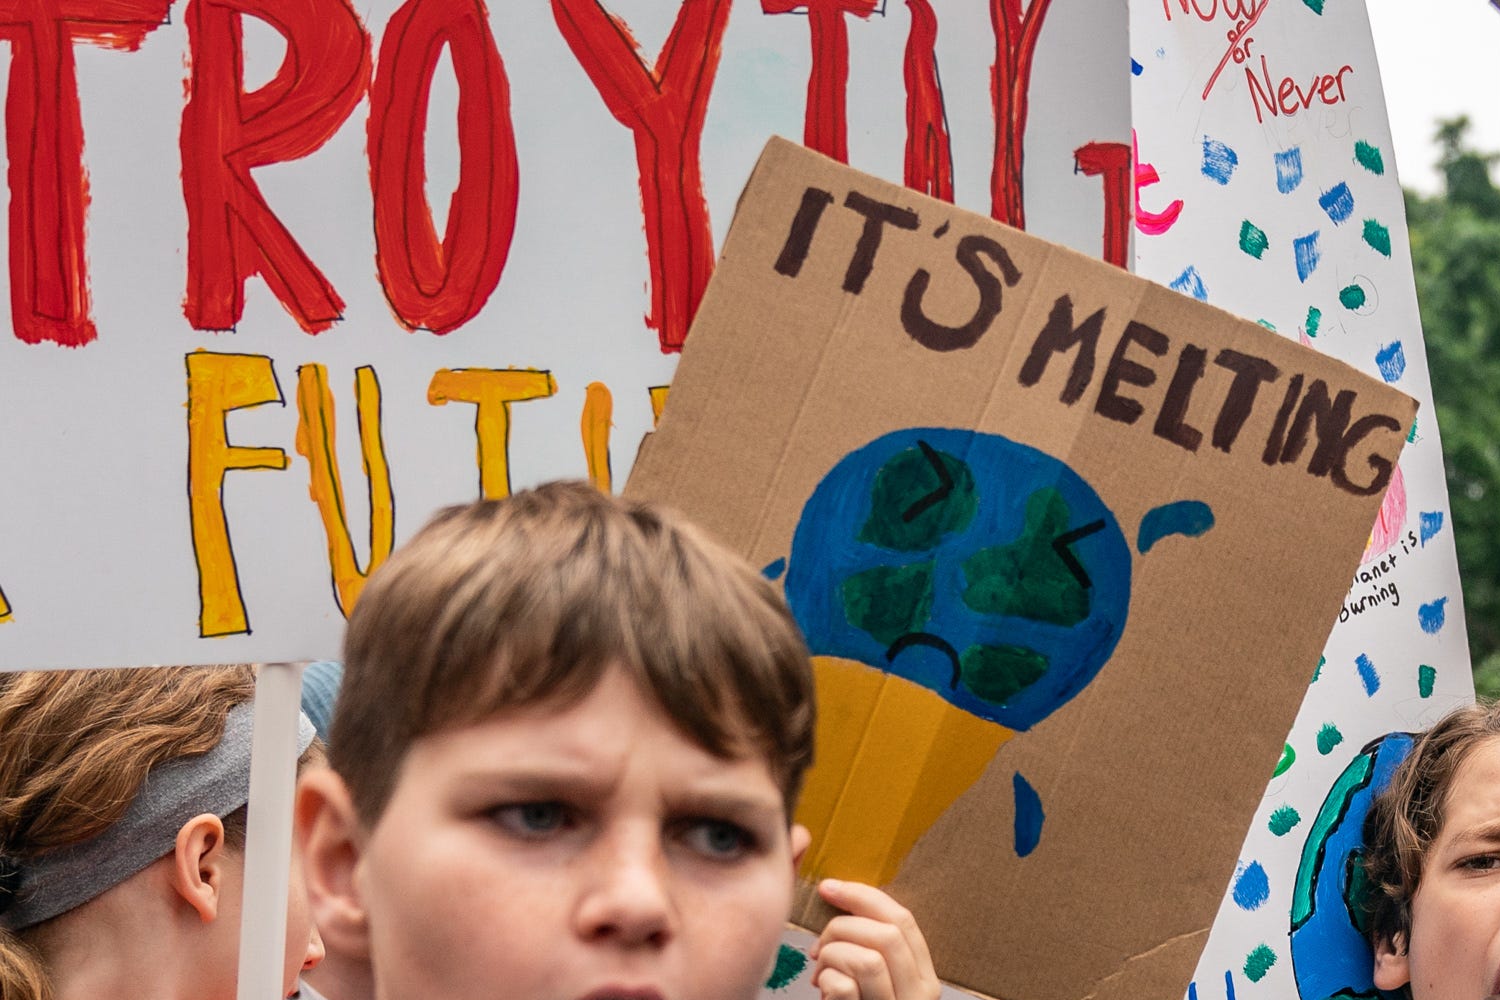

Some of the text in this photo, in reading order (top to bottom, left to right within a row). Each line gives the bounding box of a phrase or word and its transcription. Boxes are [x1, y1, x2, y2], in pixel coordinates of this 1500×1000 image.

[1245, 55, 1353, 123] Never
[774, 186, 1400, 496] IT'S MELTING
[1401, 530, 1418, 555] is
